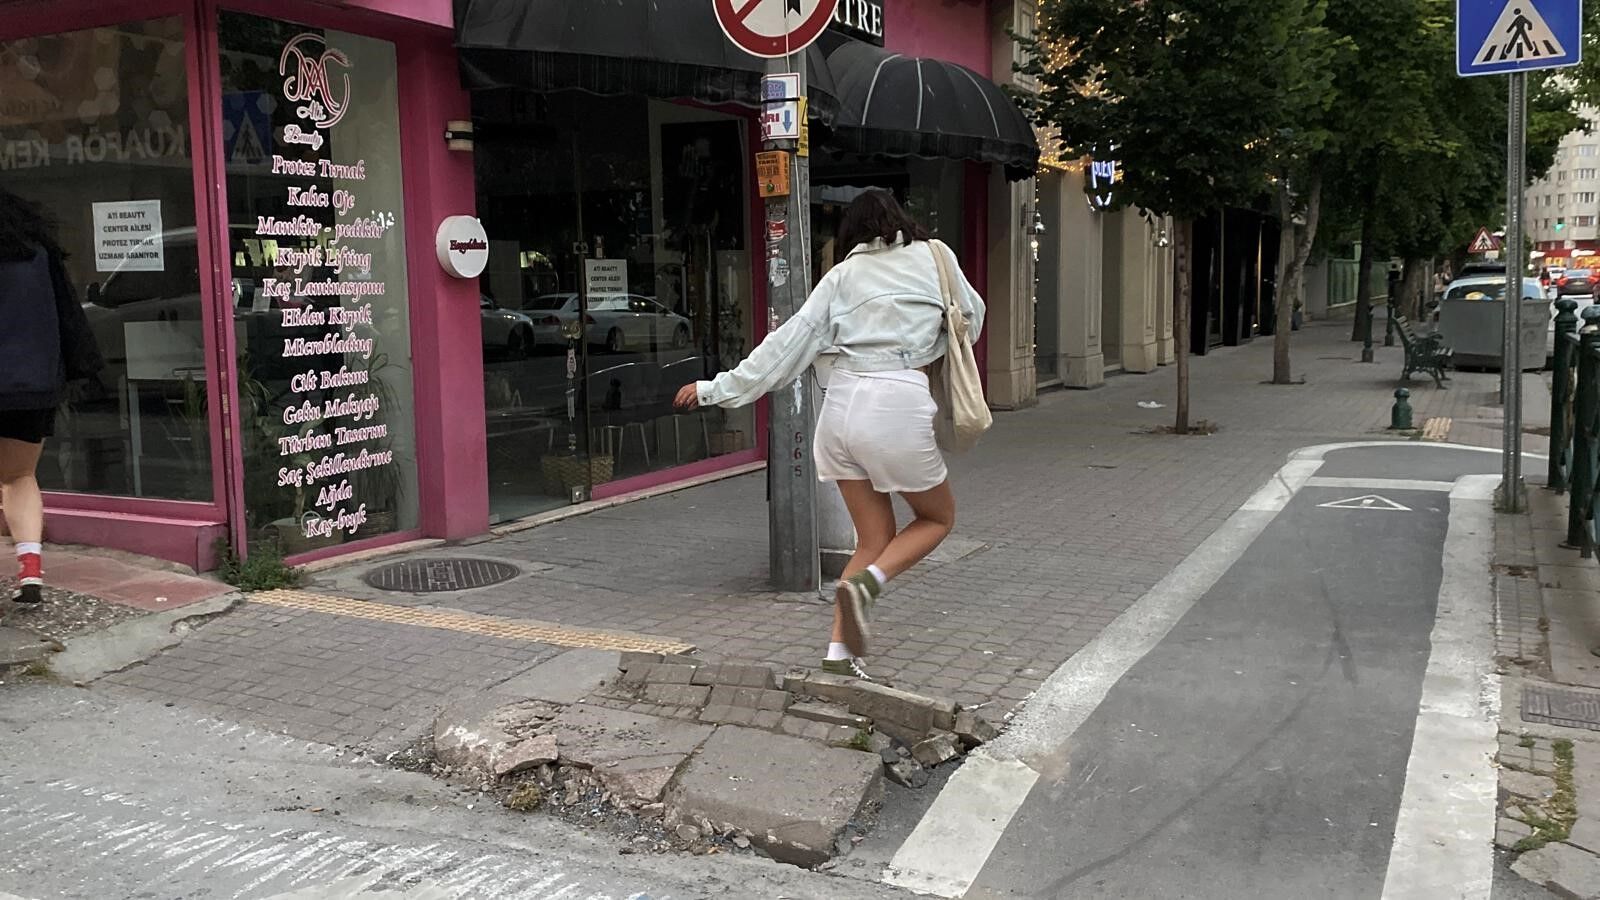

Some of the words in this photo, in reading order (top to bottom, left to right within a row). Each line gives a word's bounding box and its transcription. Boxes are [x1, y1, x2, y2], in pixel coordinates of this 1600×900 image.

[284, 124, 324, 151] Beauty
[272, 155, 316, 177] Protez
[318, 158, 366, 180] Tırnak
[287, 185, 329, 208] Kalıcı
[332, 189, 356, 216] Oje
[103, 225, 129, 233] CENTER
[119, 211, 146, 219] BEAUTY
[256, 215, 322, 237] Manikür
[330, 217, 385, 245] pedikür
[275, 245, 323, 275] Kirpik
[325, 246, 372, 275] Lifting
[262, 278, 292, 302] Kaş
[294, 278, 385, 303] Laminasyonu
[281, 304, 325, 327] Hiden
[328, 303, 372, 331] Kirpik
[282, 332, 373, 360] Microblading
[291, 369, 317, 393] Cilt
[320, 365, 369, 390] Bakımı
[283, 400, 321, 425] Gelin
[323, 393, 380, 422] Makyajı
[278, 430, 332, 456] Türban
[335, 423, 387, 446] Tasarım
[277, 467, 303, 487] Saç
[306, 448, 393, 485] Şekillendirme
[315, 479, 353, 511] Ağda
